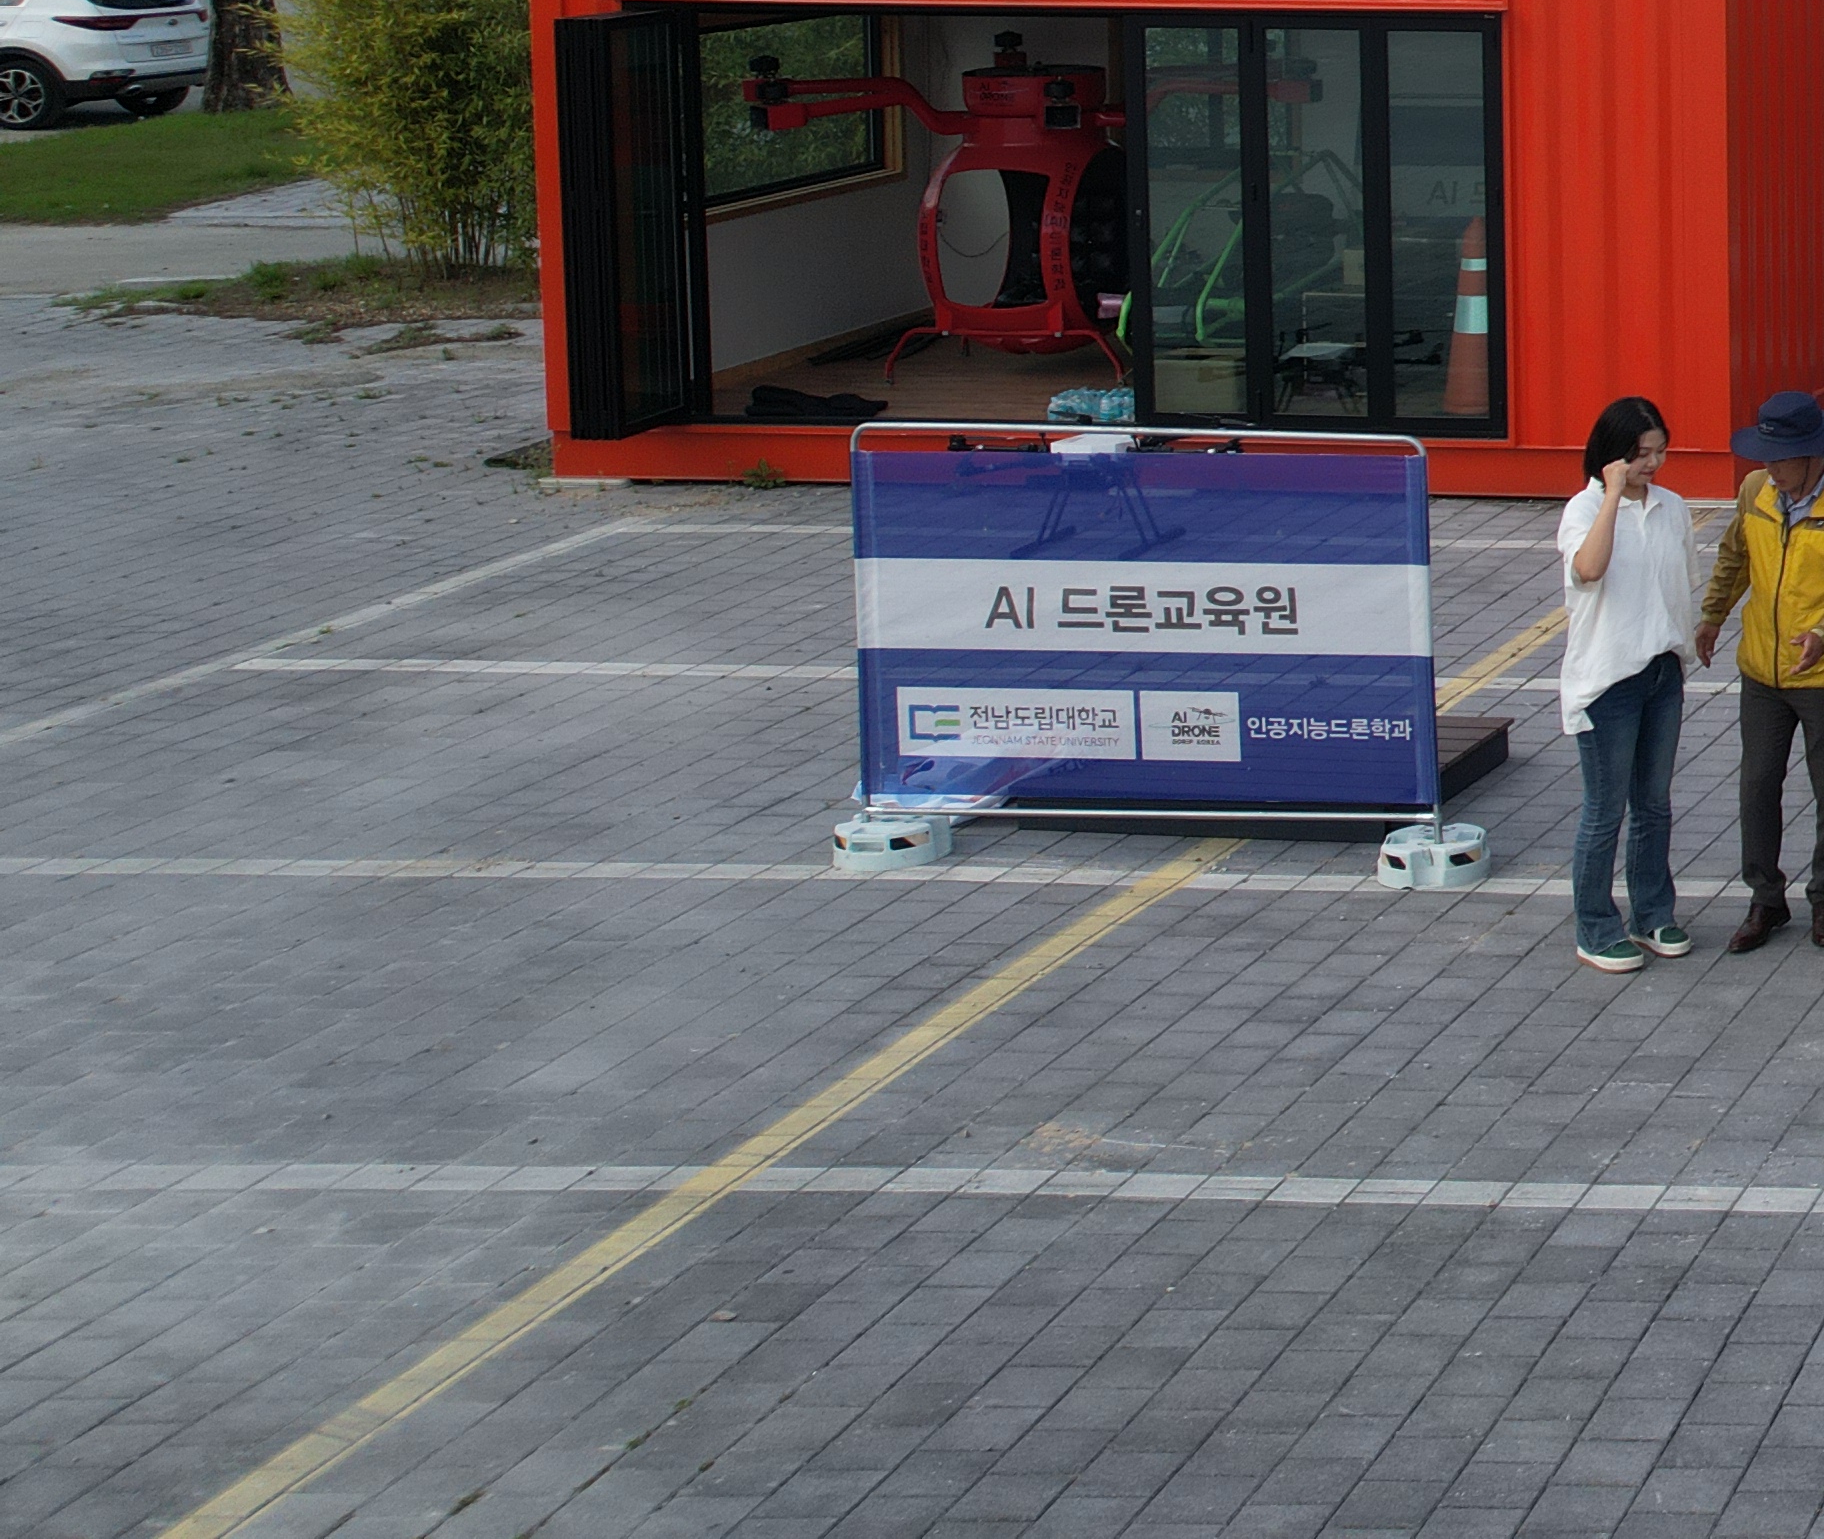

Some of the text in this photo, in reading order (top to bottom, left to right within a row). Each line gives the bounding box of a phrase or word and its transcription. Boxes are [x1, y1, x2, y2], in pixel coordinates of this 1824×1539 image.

[985, 584, 1300, 636] AI 드론교육원
[969, 705, 1120, 731] 전남도립대학교
[1171, 711, 1187, 724] AI
[1171, 725, 1221, 738] DRONE
[1246, 716, 1412, 741] 인공지능드론학과
[1023, 735, 1057, 747] STATE
[1059, 736, 1120, 748] UNIVERSITY
